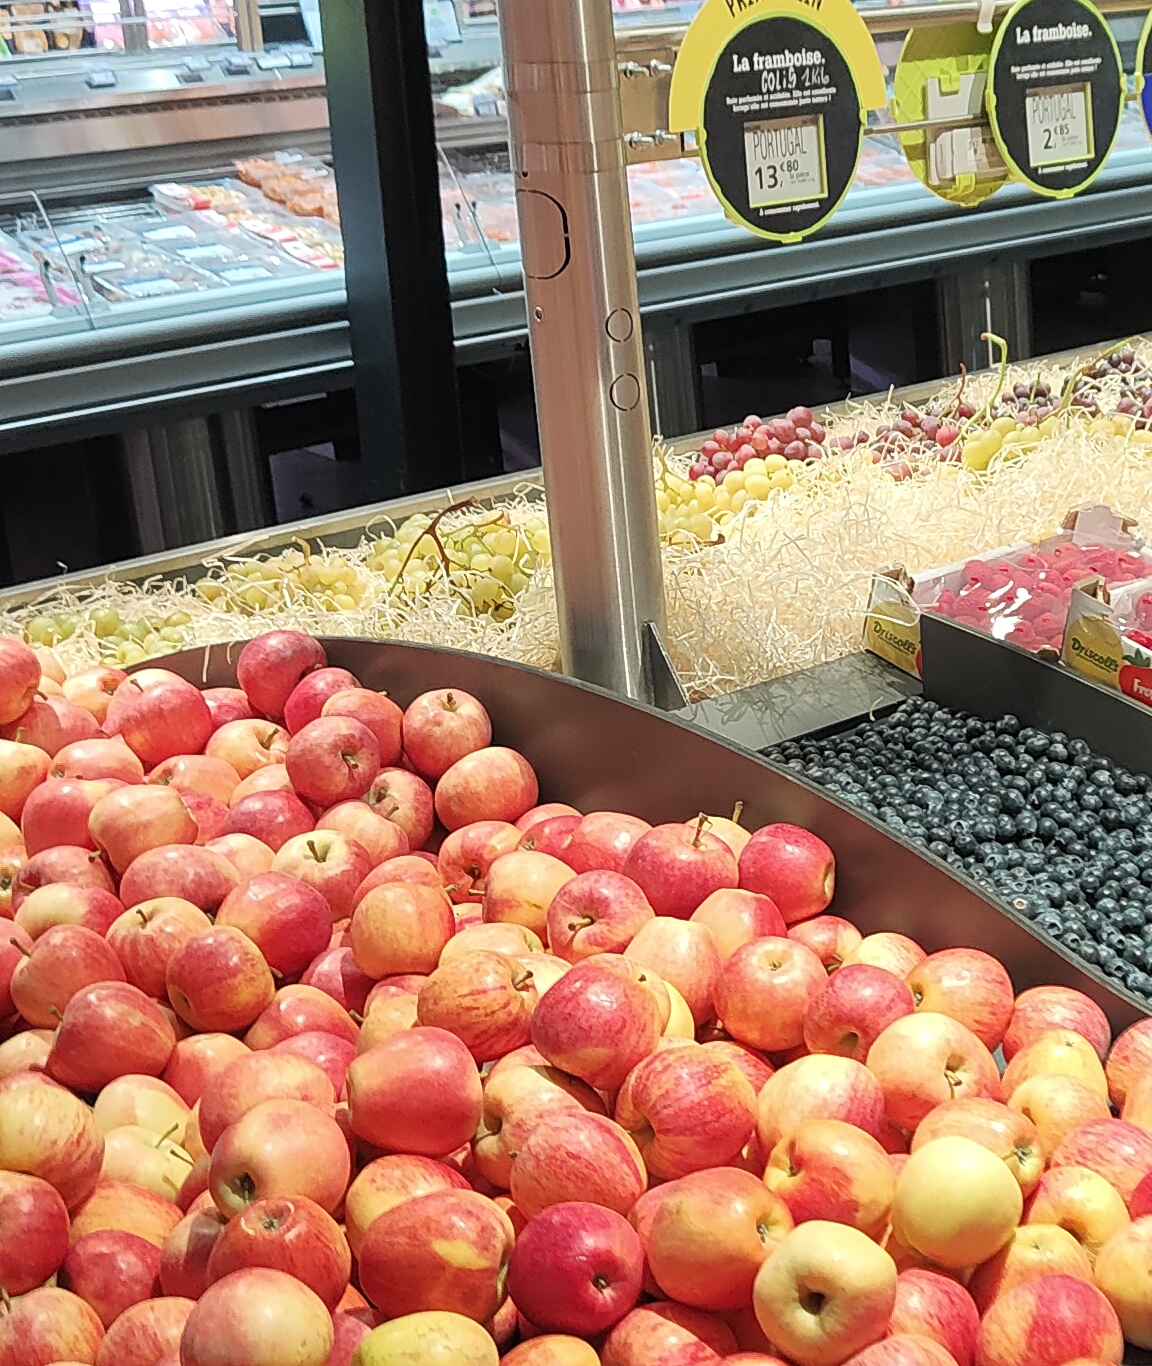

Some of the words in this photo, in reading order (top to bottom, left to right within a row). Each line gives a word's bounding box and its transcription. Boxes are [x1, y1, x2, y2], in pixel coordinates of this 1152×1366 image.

[1016, 26, 1031, 44] La
[1032, 22, 1093, 43] framboise.
[732, 54, 750, 73] La
[753, 48, 825, 70] framboise.
[1032, 93, 1076, 125] PORTUGAL
[752, 126, 807, 161] PORTUGAL
